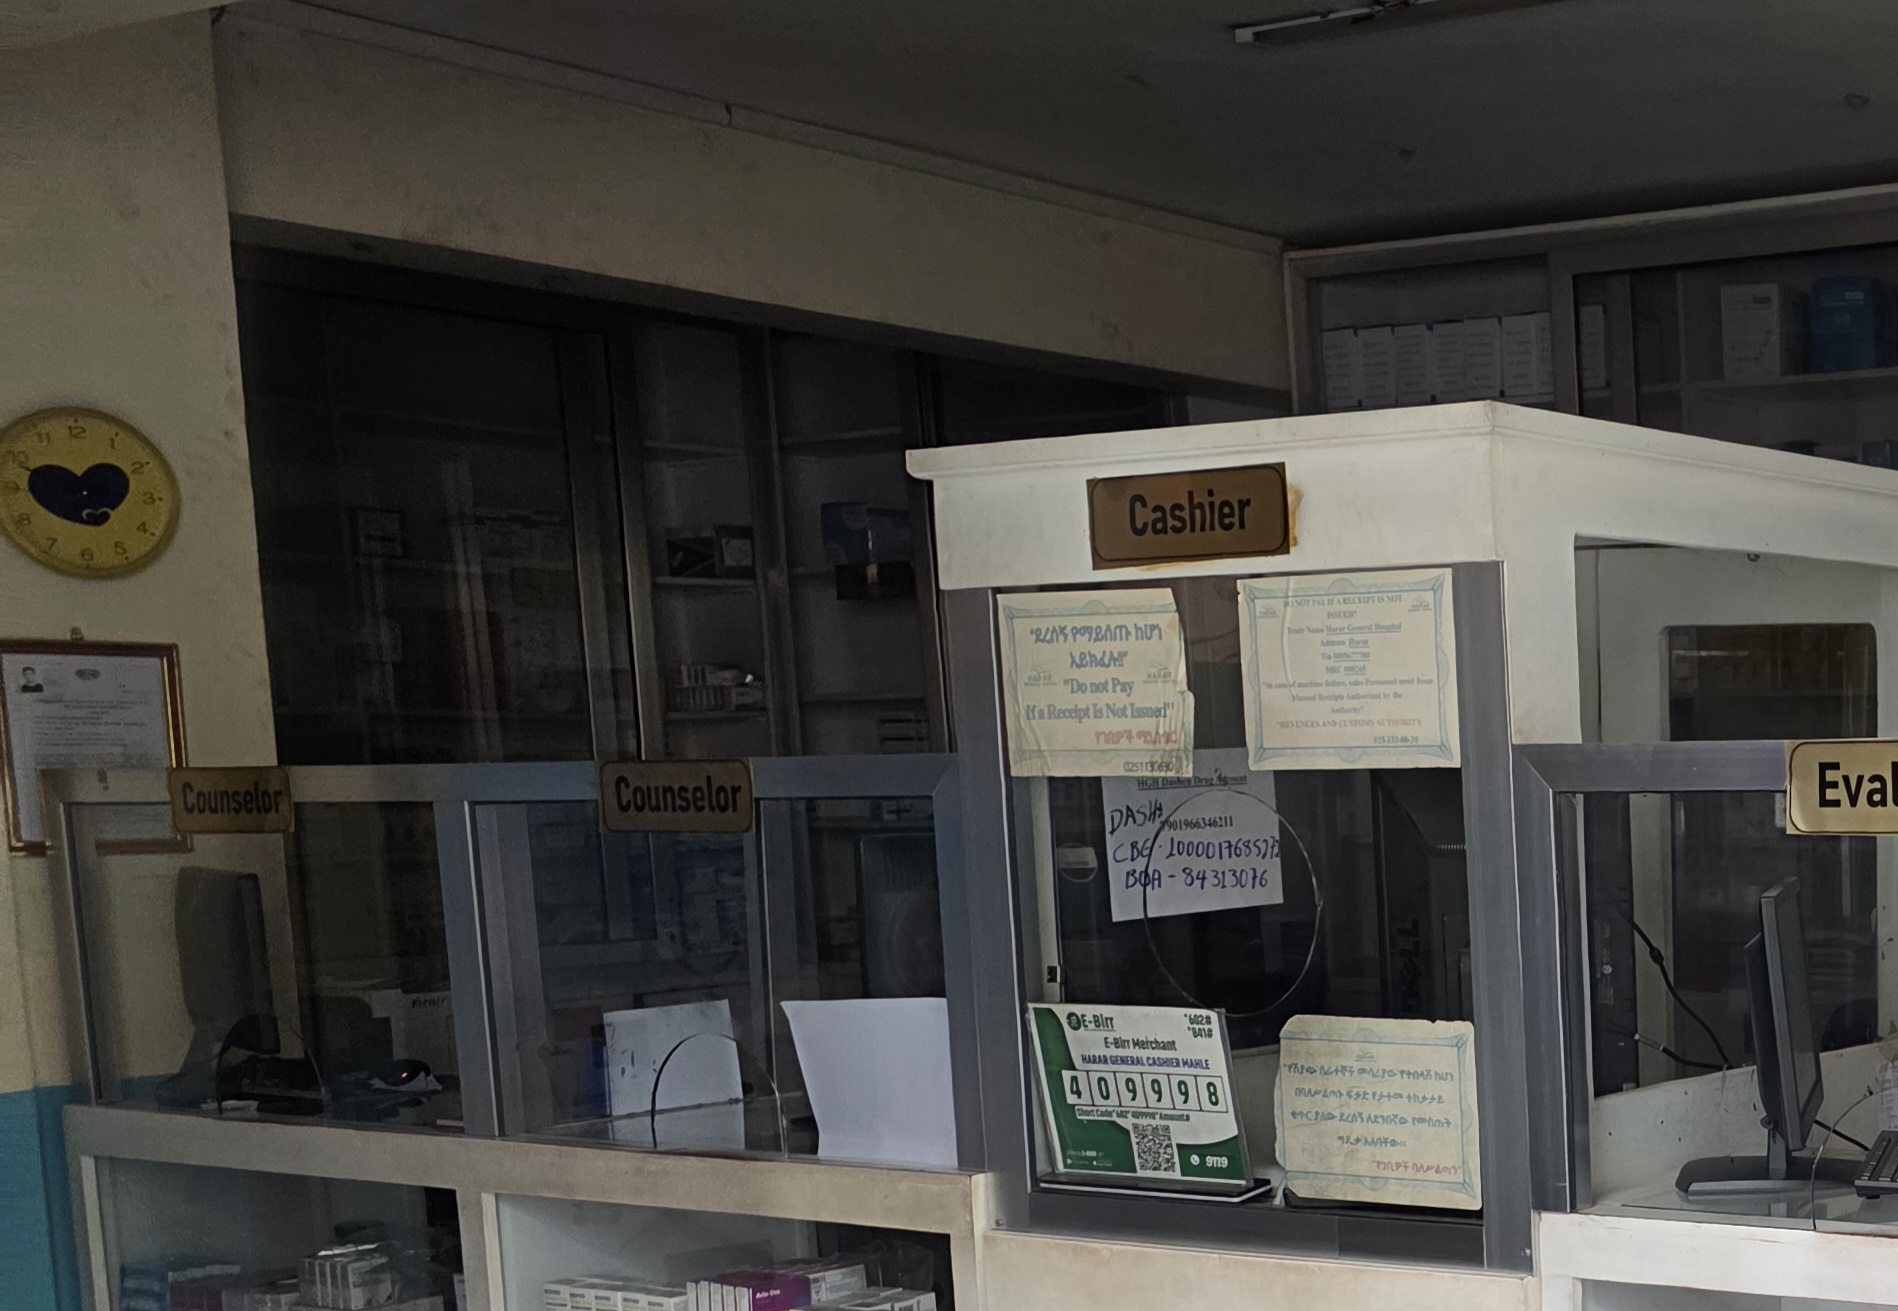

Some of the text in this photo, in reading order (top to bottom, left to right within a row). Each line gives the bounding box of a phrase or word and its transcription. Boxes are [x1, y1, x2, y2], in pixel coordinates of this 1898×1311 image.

[68, 425, 86, 439] 12
[131, 461, 145, 475] 2
[142, 491, 156, 505] 3
[1129, 488, 1252, 537] Cashier
[136, 521, 148, 535] 4
[81, 548, 95, 562] 6
[114, 541, 127, 556] 5
[1111, 677, 1134, 697] Pay
[1047, 704, 1090, 724] Receipt
[1105, 703, 1129, 720] Not
[182, 780, 284, 815] Counselor
[615, 775, 744, 814] Counselor
[1182, 866, 1269, 891] 84313076
[1132, 1037, 1178, 1052] Merchant
[1080, 1054, 1110, 1066] HARAR
[1110, 1055, 1146, 1068] GENERAL
[1146, 1057, 1181, 1069] CASHIER
[1205, 1154, 1229, 1169] 9119
